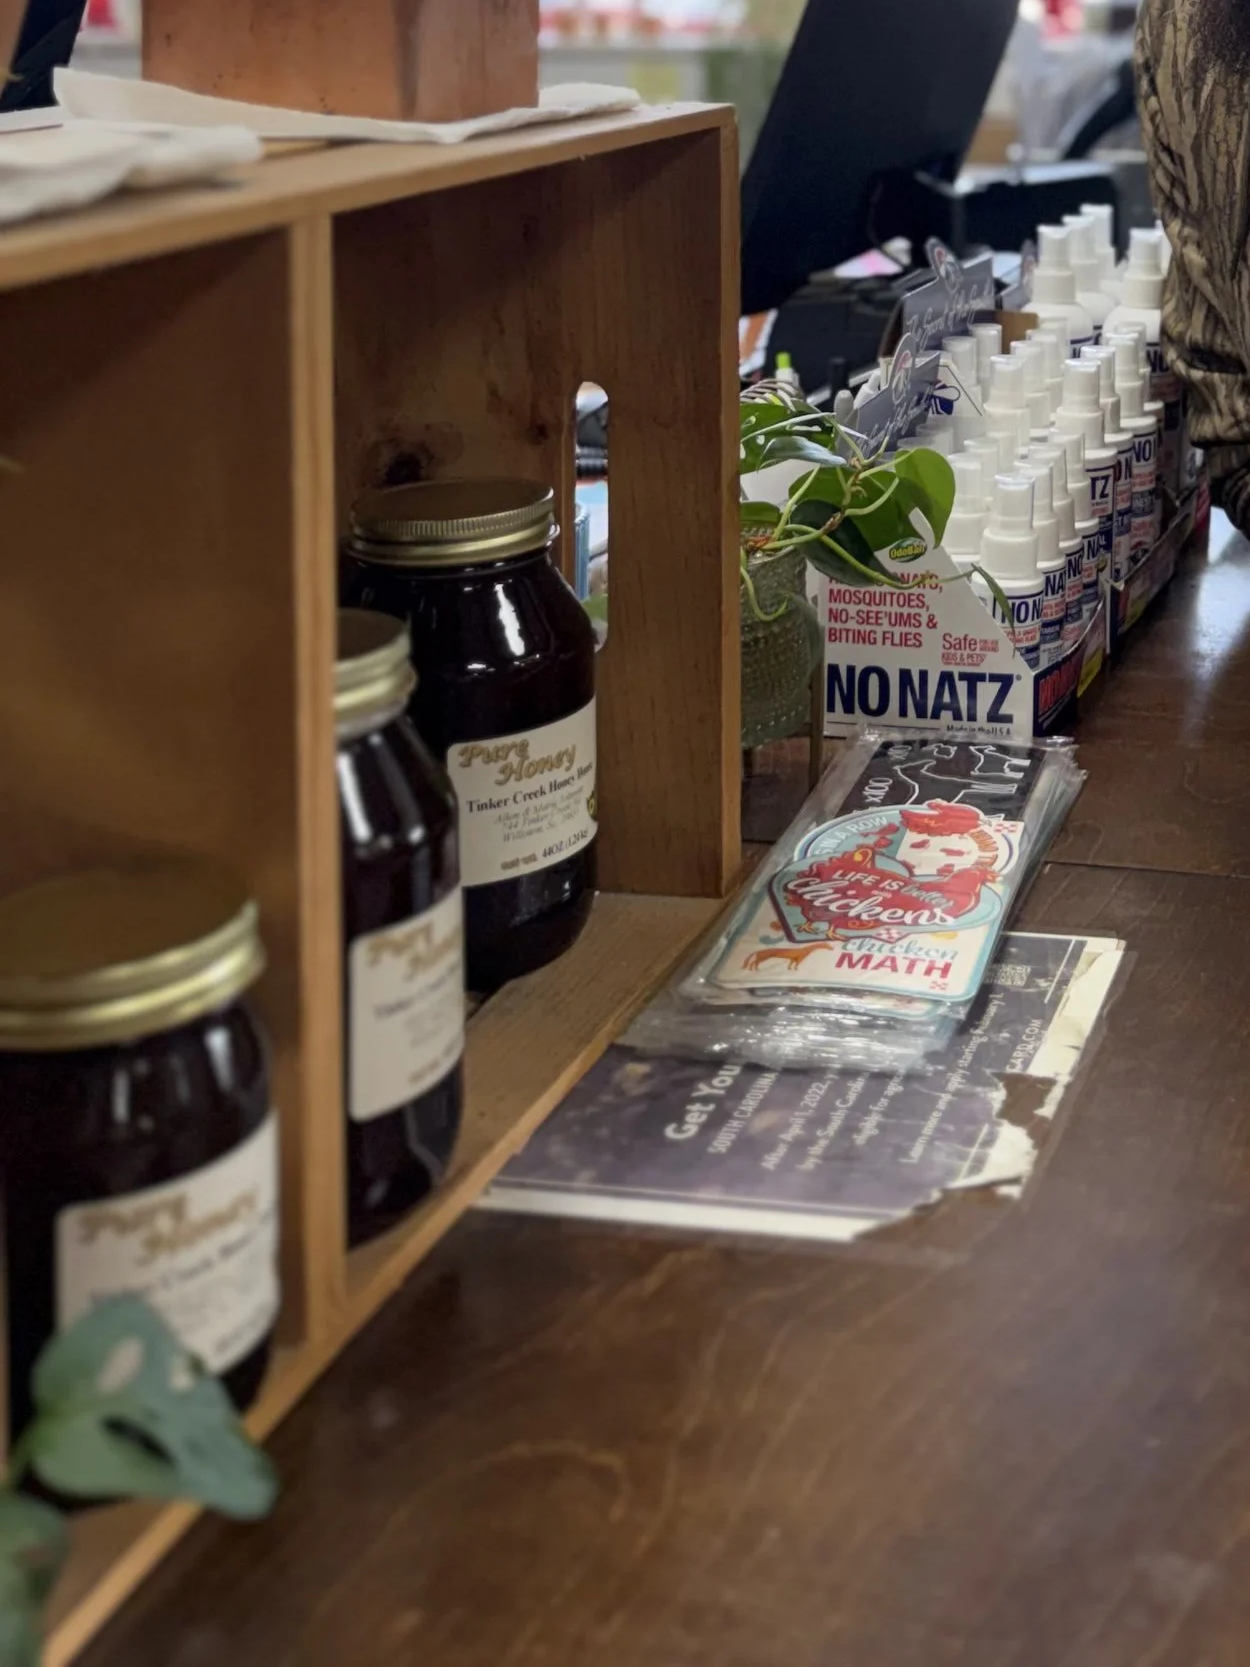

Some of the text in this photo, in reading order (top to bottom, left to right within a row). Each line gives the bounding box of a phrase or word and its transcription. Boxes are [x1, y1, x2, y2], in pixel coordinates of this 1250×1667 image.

[828, 588, 930, 612] MOSQUITOES,
[827, 607, 938, 630] NO-SEE'UMS &
[828, 627, 923, 649] BITING FLIES
[941, 632, 978, 652] Safe
[826, 663, 891, 718] NO
[897, 667, 1015, 725] NATZ
[457, 738, 531, 769] Pure
[493, 744, 577, 787] Honey
[465, 795, 511, 814] Tinker
[511, 785, 549, 806] Creek
[831, 869, 881, 886] LIFE
[878, 877, 905, 891] IS
[834, 951, 953, 980] MATH
[957, 1037, 988, 1069] starting
[663, 1064, 743, 1140] Get You
[706, 1072, 780, 1154] SOUTH CAROLINA
[868, 1096, 890, 1112] for
[777, 1116, 807, 1142] April
[815, 1108, 849, 1137] South
